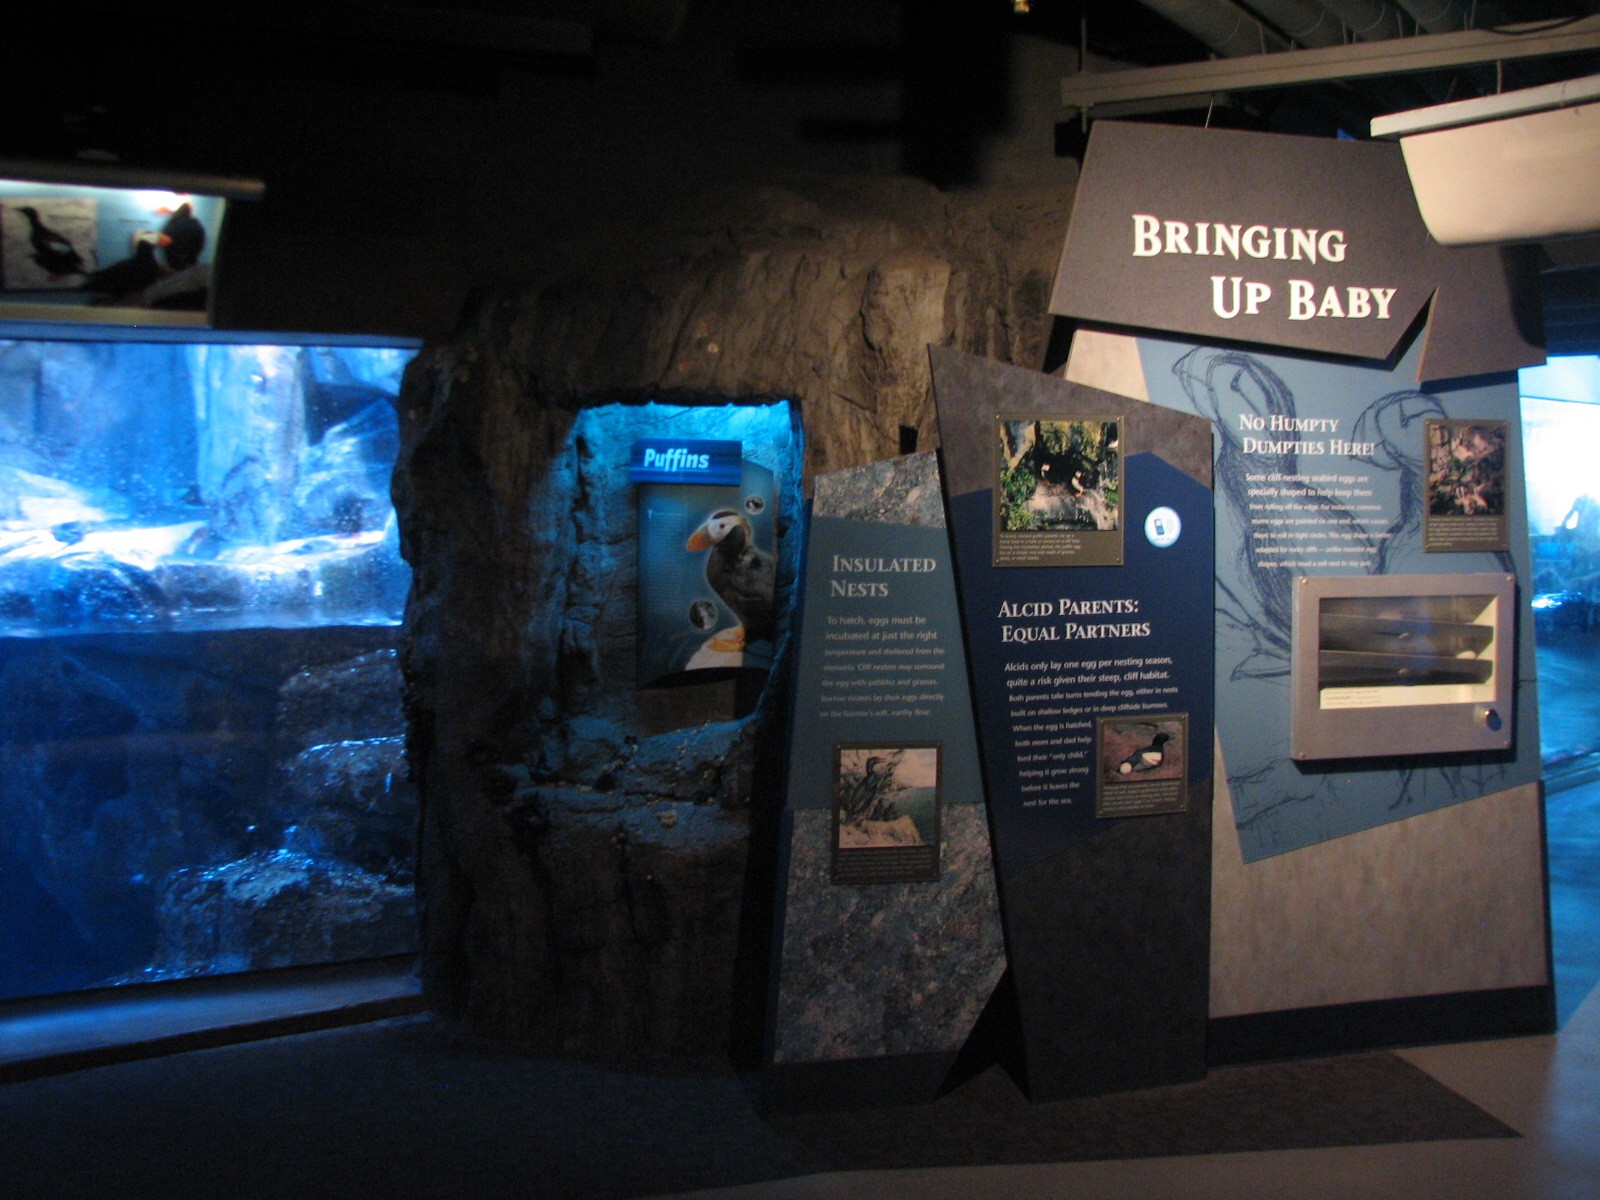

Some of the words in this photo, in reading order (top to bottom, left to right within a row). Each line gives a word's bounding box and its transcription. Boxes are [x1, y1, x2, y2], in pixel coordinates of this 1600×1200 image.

[1132, 214, 1348, 265] BRINGING
[1210, 276, 1272, 319] UP
[1288, 279, 1397, 321] BABY
[1240, 414, 1265, 431] NO
[1270, 415, 1339, 432] HUMPTY
[1243, 437, 1325, 455] DUMPTIES
[1329, 439, 1374, 455] HERE!
[644, 448, 709, 472] Puffins
[1246, 473, 1266, 481] Some
[832, 555, 936, 572] INSULATED
[831, 580, 888, 597] NESTS
[998, 600, 1053, 618] ALCID
[1059, 598, 1139, 616] PARENTS:
[915, 616, 927, 624] be
[826, 632, 869, 640] incubated
[882, 632, 897, 642] just
[899, 631, 914, 639] the
[916, 631, 937, 642] right
[1002, 625, 1059, 644] EQUAL
[1065, 622, 1151, 639] PARTNERS
[1004, 661, 1028, 671] Alcids
[1031, 660, 1048, 673] only
[1051, 659, 1061, 672] lay
[1064, 661, 1078, 669] one
[1081, 661, 1096, 671] egg
[1099, 660, 1111, 670] per
[1114, 657, 1143, 669] nesting
[1145, 657, 1172, 666] season,
[1007, 677, 1028, 689] quite
[1038, 675, 1051, 685] risk
[1054, 675, 1075, 687] given
[1078, 673, 1096, 683] their
[1099, 672, 1121, 685] steep,
[1124, 671, 1138, 681] cliff
[1140, 669, 1170, 680] habitat.
[1009, 693, 1024, 702] Both
[1026, 692, 1049, 704] parents
[1051, 691, 1064, 700] take
[1066, 691, 1082, 699] turns
[1084, 688, 1108, 701] tending
[1110, 688, 1119, 696] the
[1136, 686, 1153, 695] either
[1155, 686, 1161, 694] in
[1163, 686, 1178, 694] nests
[1011, 708, 1026, 717] built
[1038, 706, 1061, 715] shallow
[1063, 705, 1083, 717] ledges
[1101, 703, 1116, 714] deep
[1078, 736, 1091, 745] help
[1019, 769, 1043, 778] helping
[1069, 767, 1089, 776] strong
[1049, 782, 1068, 790] leaves
